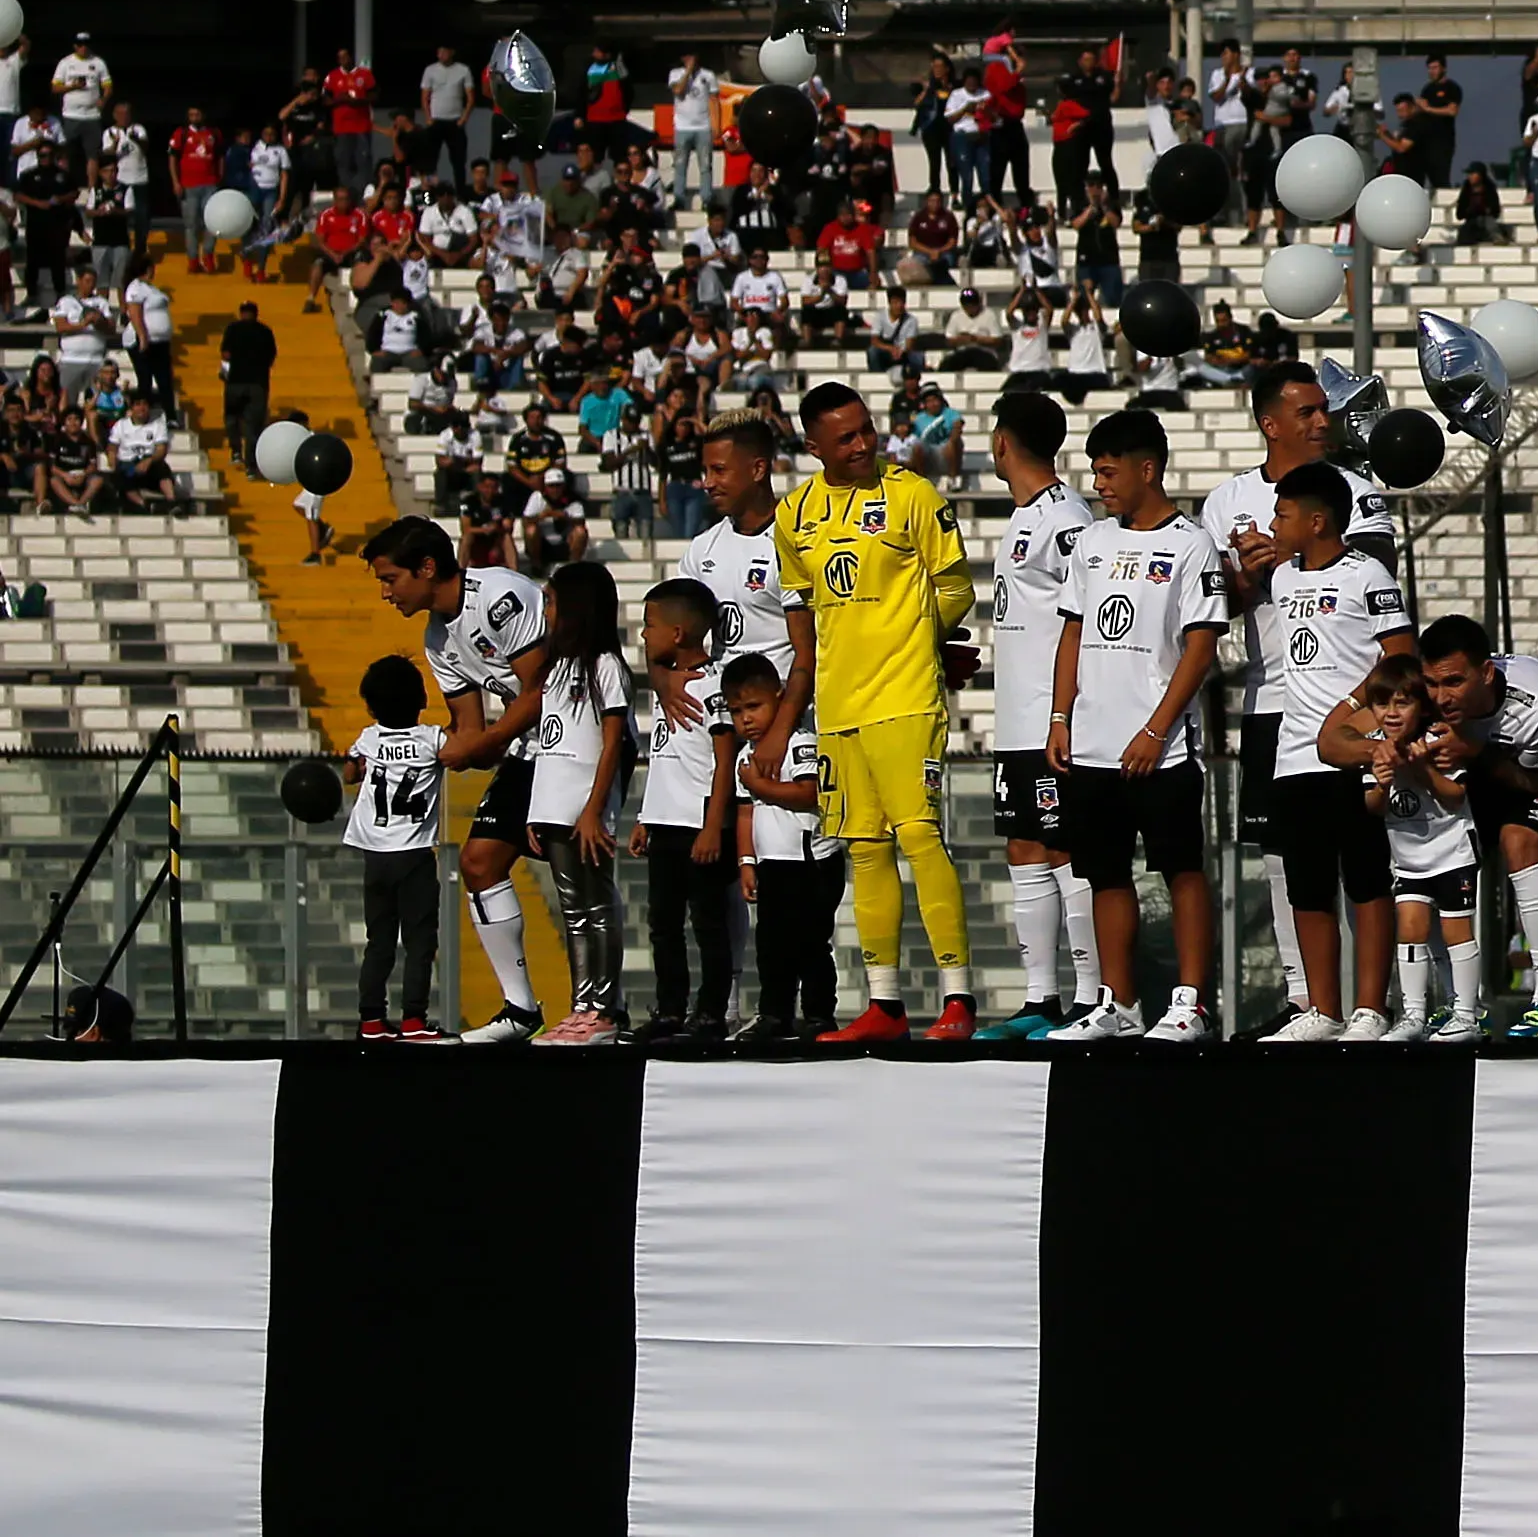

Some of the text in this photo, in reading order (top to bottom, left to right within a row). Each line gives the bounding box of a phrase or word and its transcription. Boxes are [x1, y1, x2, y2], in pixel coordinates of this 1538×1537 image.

[1101, 599, 1131, 636] MG
[1287, 599, 1316, 620] 216
[370, 765, 428, 828] 14
